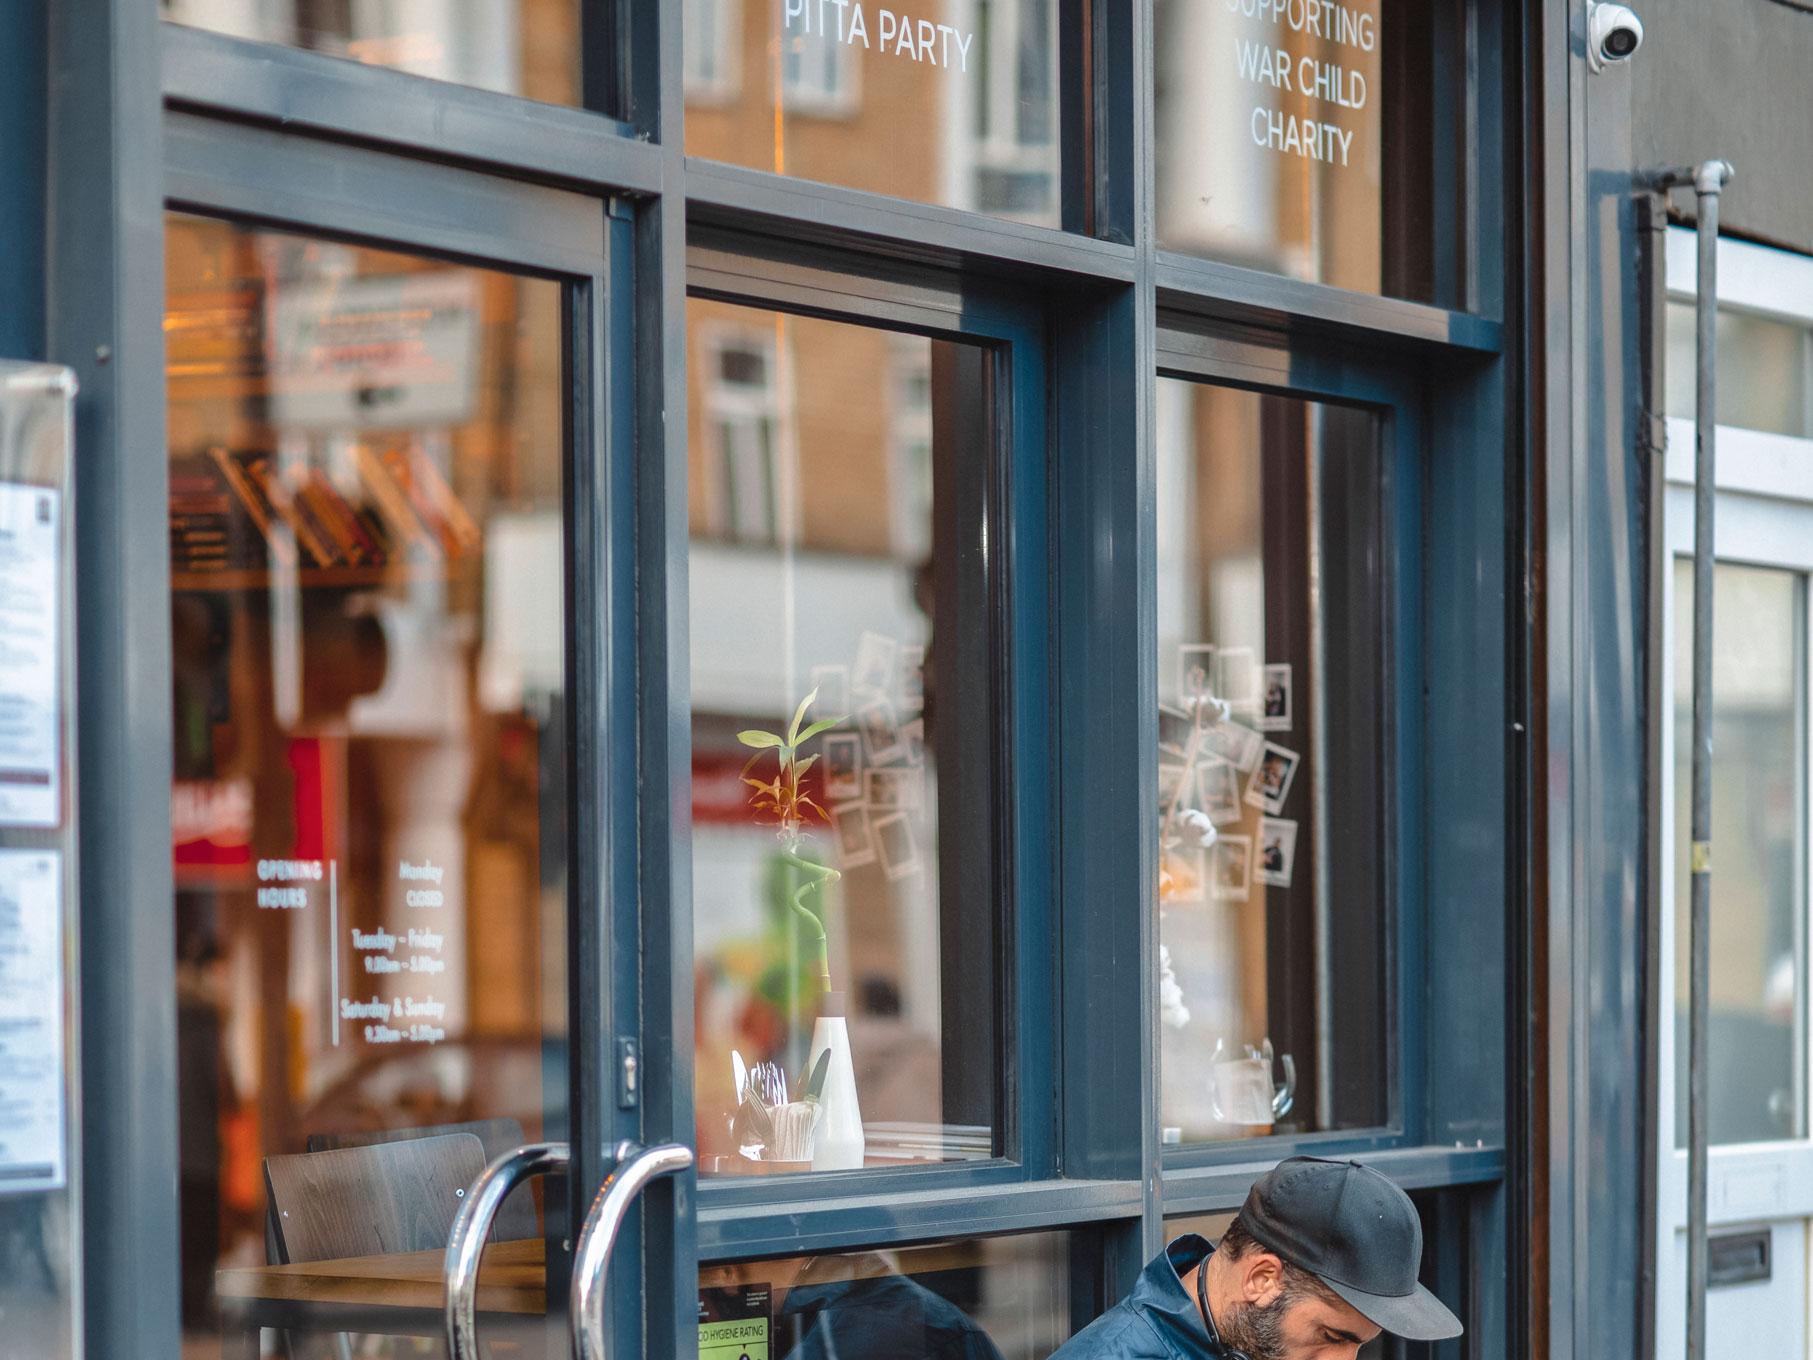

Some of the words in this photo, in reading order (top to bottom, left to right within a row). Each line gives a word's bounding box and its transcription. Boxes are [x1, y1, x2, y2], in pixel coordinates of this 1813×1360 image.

[785, 0, 870, 49] PITTA
[878, 9, 974, 73] PARTY
[1226, 0, 1375, 51] PPORTING
[1235, 38, 1293, 92] WAR
[1297, 56, 1367, 110] CHILD
[1251, 106, 1354, 167] CHARITY
[257, 859, 323, 881] OPENING
[399, 858, 444, 886] Monday
[257, 887, 307, 909] HOURS
[351, 926, 397, 955] Tuesday
[408, 926, 444, 954] Friday
[340, 995, 392, 1023] Saturday
[404, 995, 446, 1021] Sunday
[710, 1326, 739, 1341] HYGIENE
[739, 1324, 764, 1337] RATING
